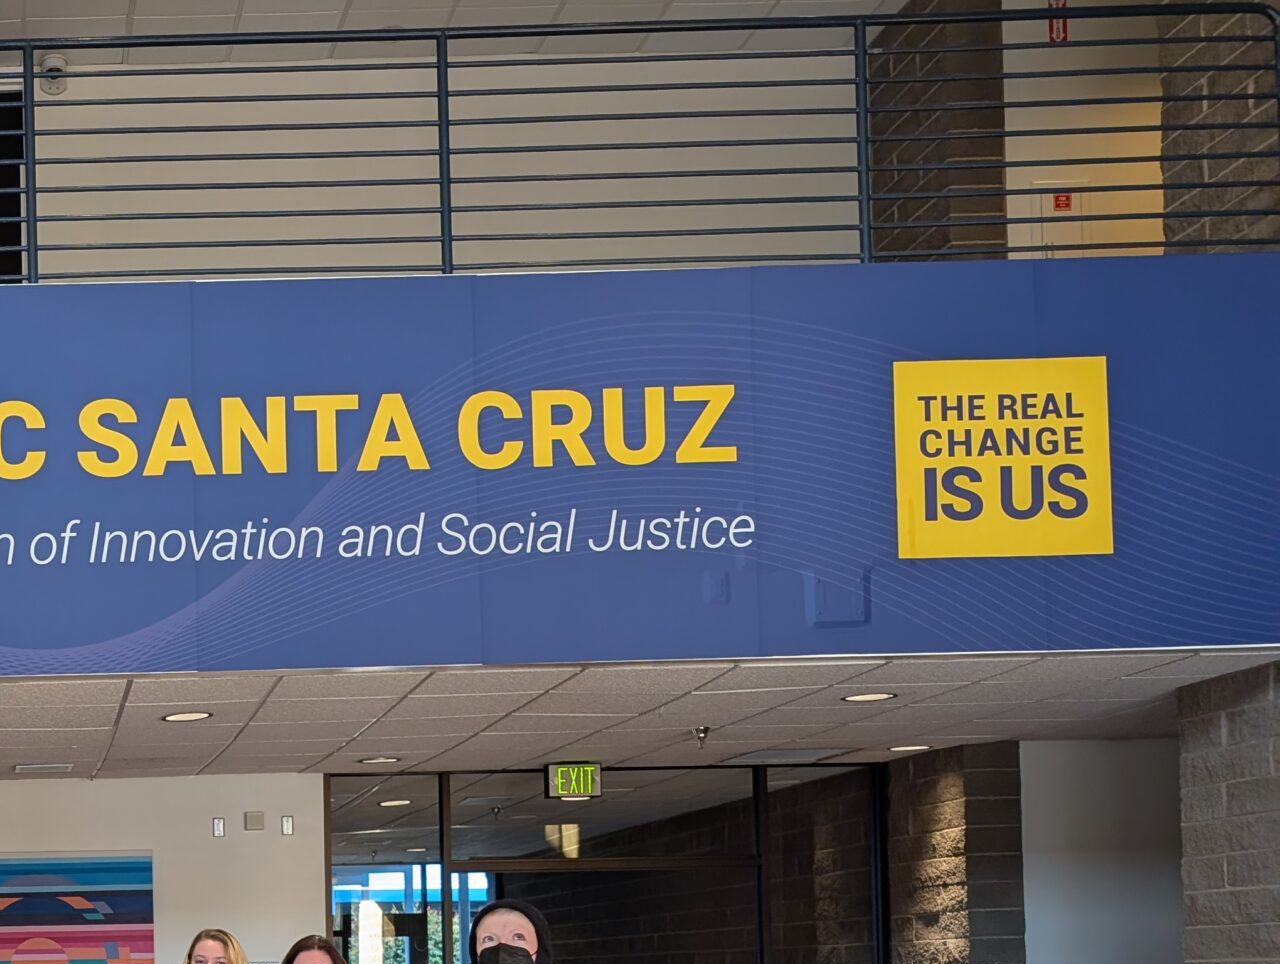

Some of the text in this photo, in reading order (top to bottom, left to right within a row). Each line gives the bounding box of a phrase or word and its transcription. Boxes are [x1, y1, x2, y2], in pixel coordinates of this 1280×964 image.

[917, 393, 1085, 421] THE REAL
[77, 393, 430, 479] SANTA
[458, 384, 739, 471] CRUZ
[920, 426, 1085, 458] CHANGE
[924, 464, 1088, 522] IS US
[29, 519, 81, 565] of
[89, 517, 325, 563] Innovation
[338, 512, 427, 558] and
[437, 508, 577, 556] Social
[588, 506, 756, 552] Justice
[556, 766, 596, 795] EXIT
